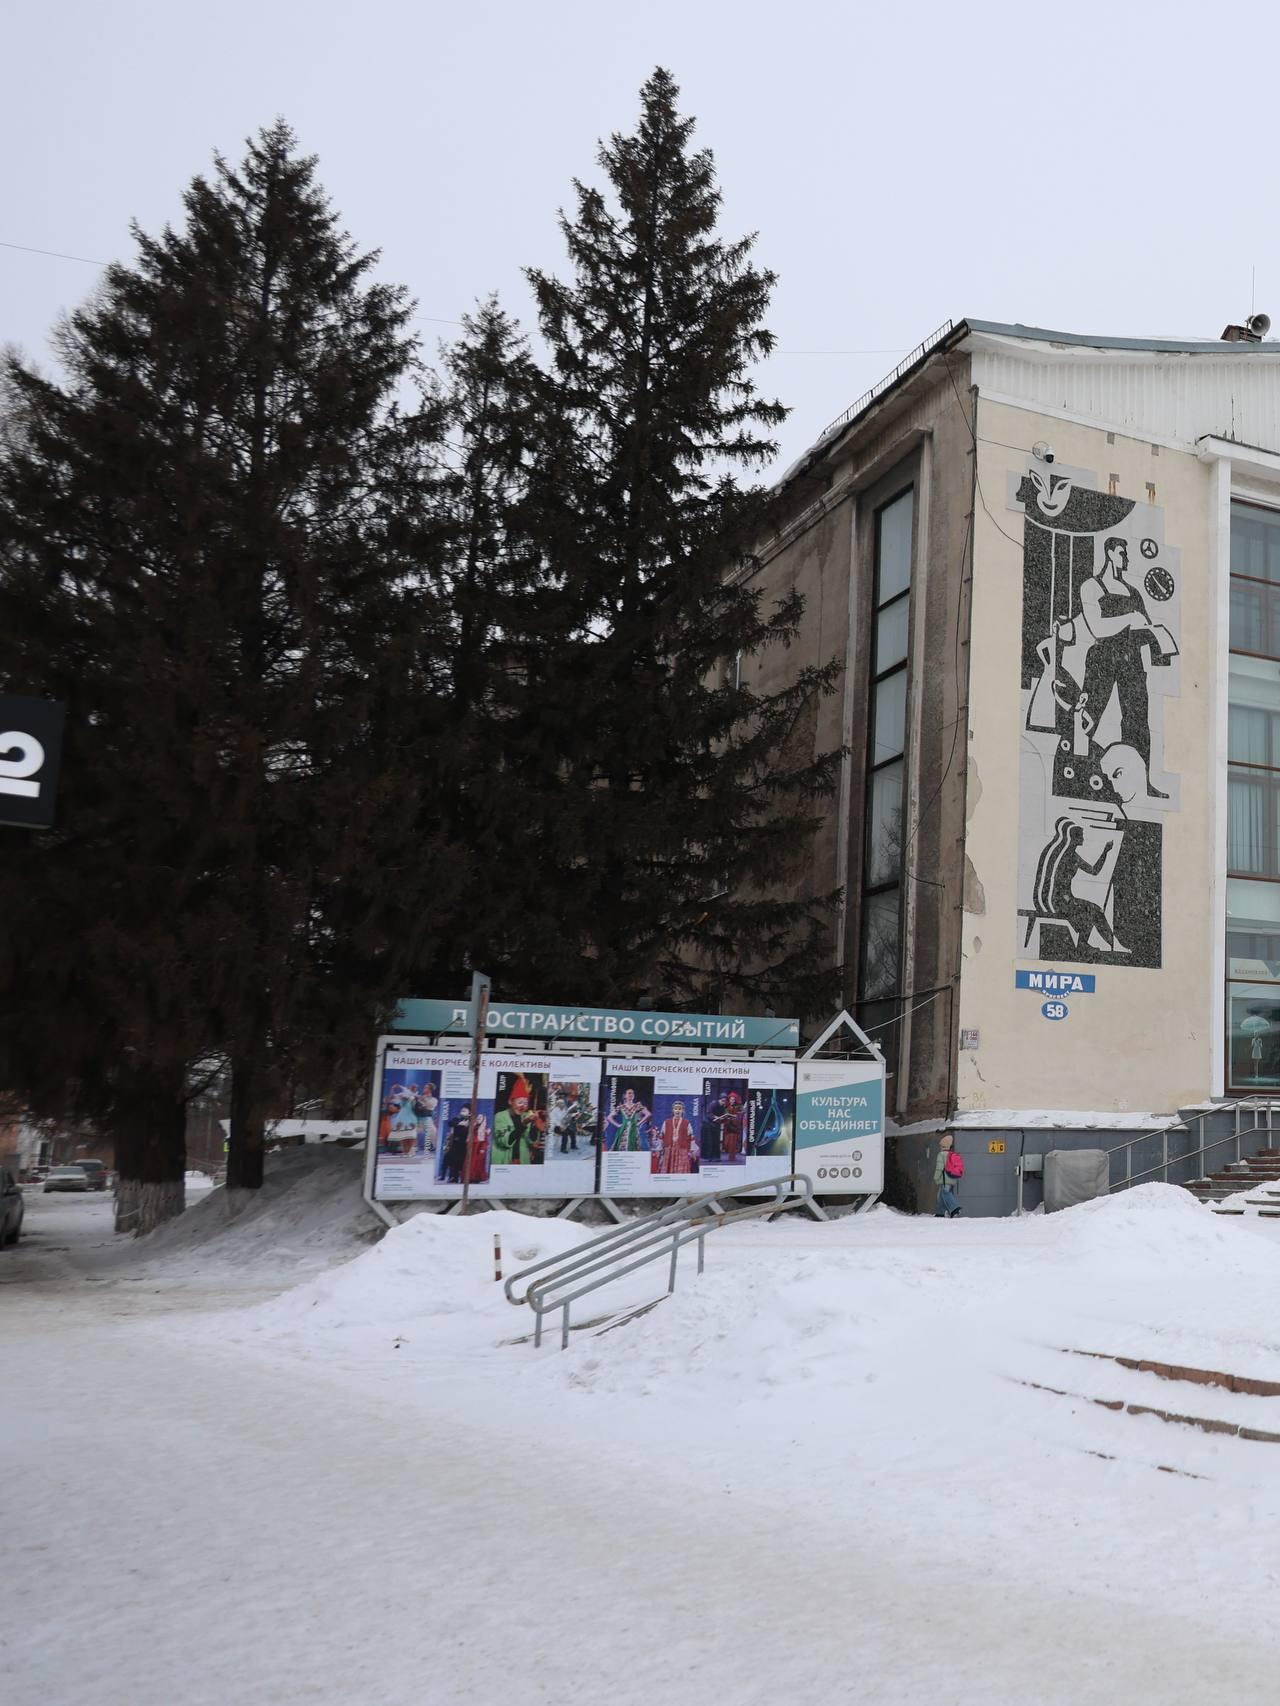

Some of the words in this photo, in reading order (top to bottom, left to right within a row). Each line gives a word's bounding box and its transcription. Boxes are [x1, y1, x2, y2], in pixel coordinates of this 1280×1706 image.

[1029, 973, 1083, 991] МИРА
[1046, 1004, 1064, 1018] 58
[452, 1009, 635, 1034] ПОСТРАНСТВО
[641, 1018, 745, 1039] СОБЫТИЙ
[393, 1057, 423, 1066] НАШИ
[425, 1058, 487, 1068] ТВОРЧЕСЕ
[489, 1058, 551, 1069] КОЛЛЕКТИВЫ
[612, 1064, 638, 1073] НАШИ
[641, 1065, 694, 1074] ТВОРЧЕСКИЕ
[696, 1067, 750, 1075] КОЛЛЕКТИВЫ
[811, 1097, 867, 1107] КУЛЬТУРА
[828, 1109, 851, 1118] НАС
[800, 1120, 878, 1132] ОБЪЕДИНЯЕТ
